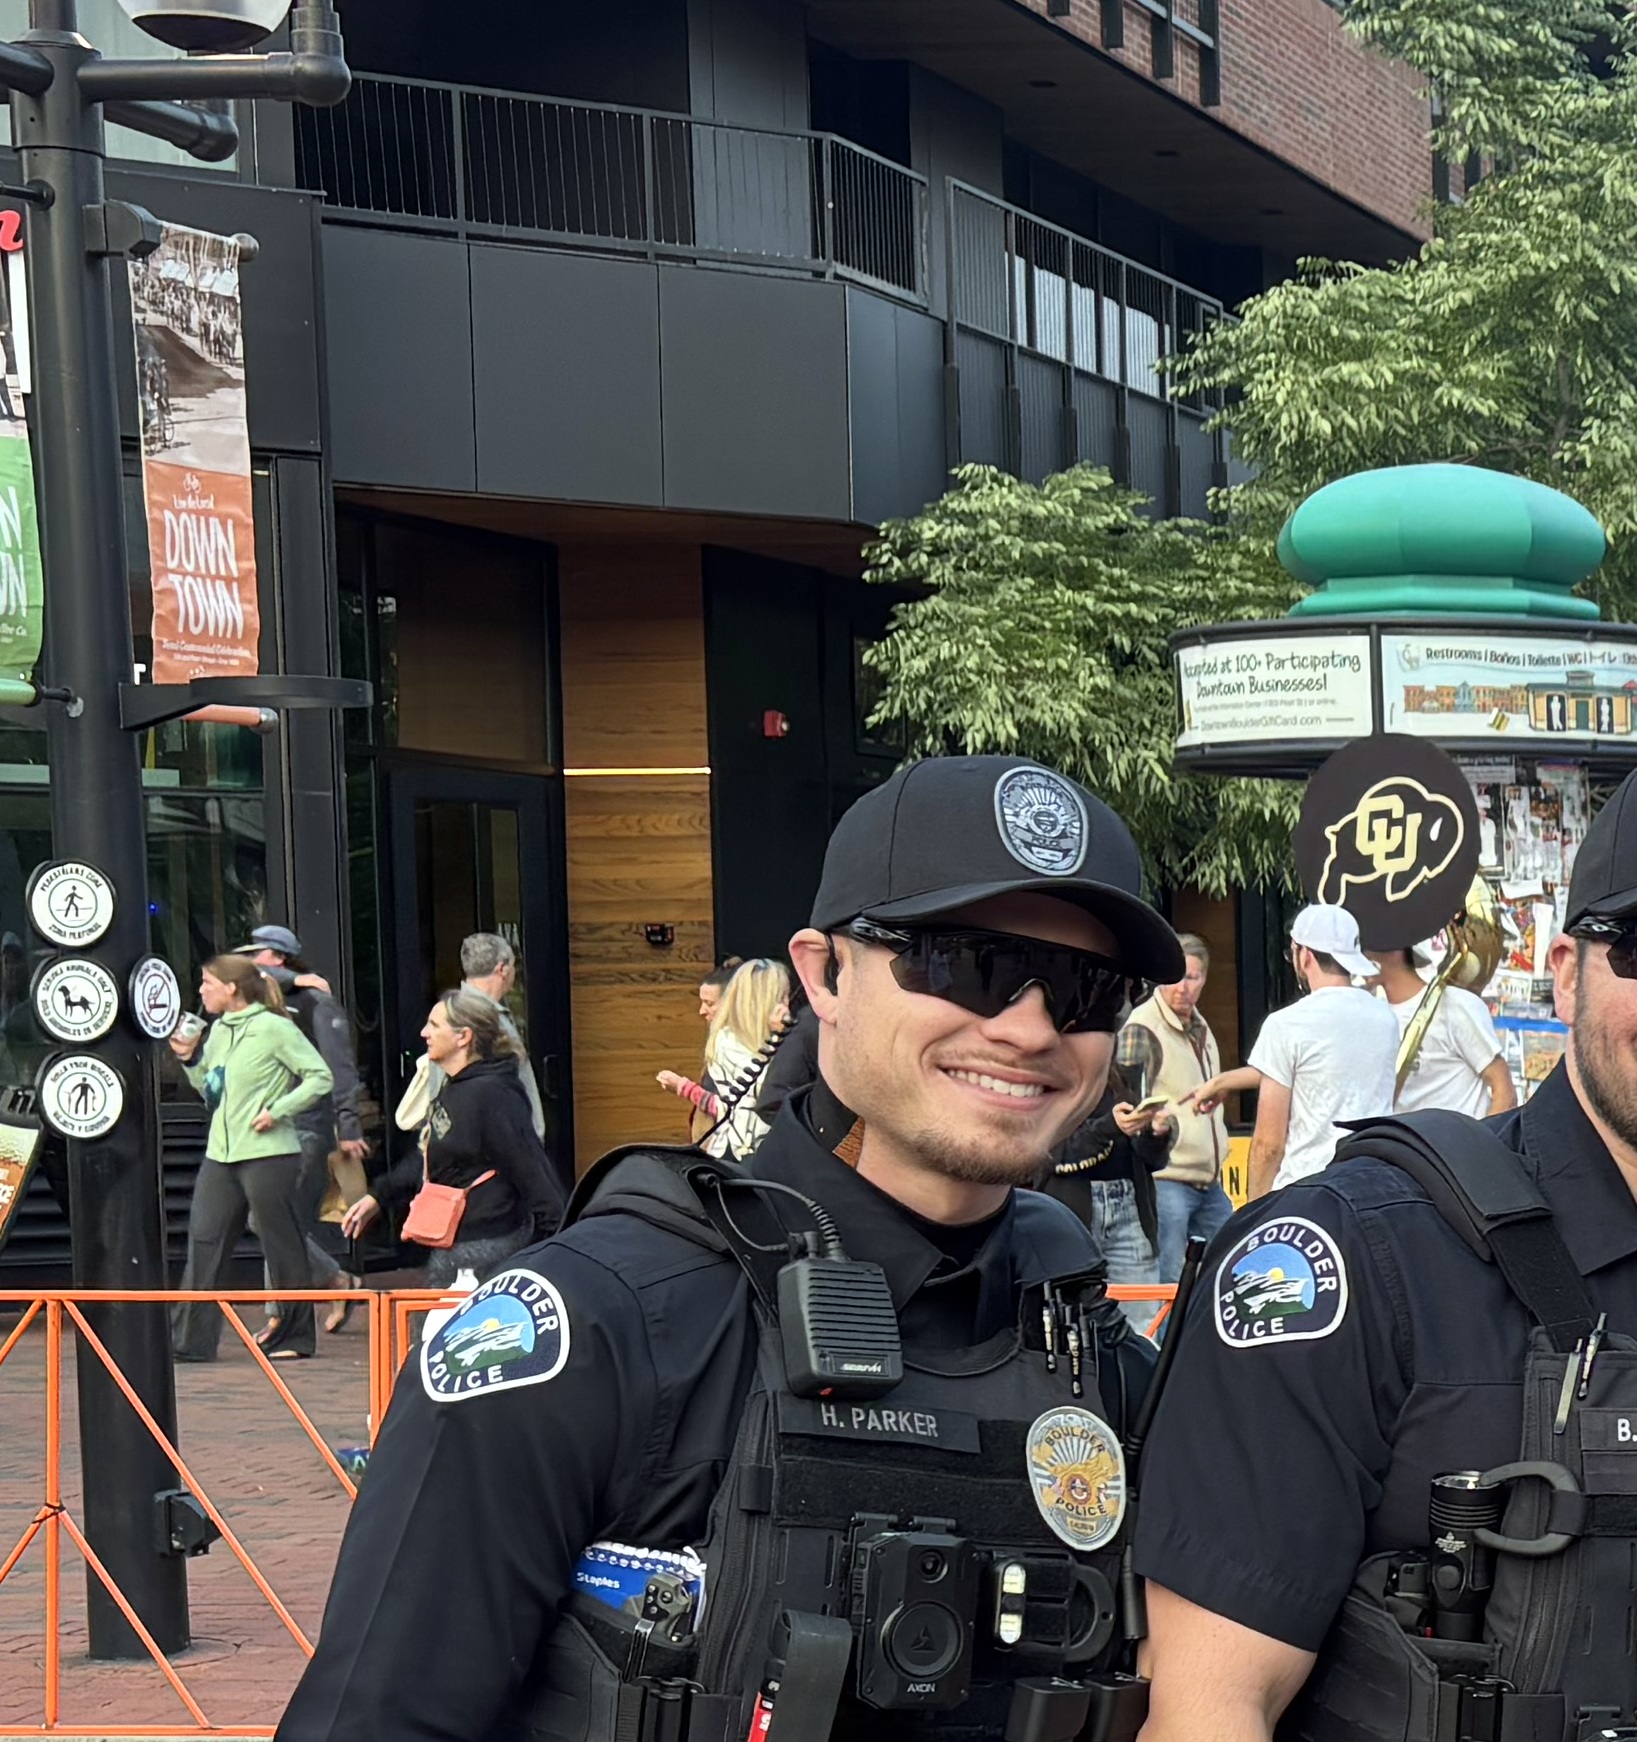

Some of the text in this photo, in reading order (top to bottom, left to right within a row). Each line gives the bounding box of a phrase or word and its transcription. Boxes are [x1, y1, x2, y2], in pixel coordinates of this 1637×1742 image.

[163, 509, 239, 578] DOWN
[168, 573, 244, 640] TOWN
[1220, 657, 1232, 676] at
[1236, 653, 1262, 674] 100+
[1265, 650, 1361, 673] Participating
[1425, 647, 1483, 660] Restrooms
[1248, 673, 1328, 695] Businesses!
[1355, 794, 1423, 874] CU
[1246, 1224, 1337, 1293] BOULDER
[1220, 1290, 1285, 1340] POLICE
[428, 1350, 504, 1393] POLICE
[821, 1403, 938, 1438] H. PARKER
[1044, 1426, 1106, 1453] BOULDER
[1055, 1497, 1107, 1517] POLICE
[576, 1571, 621, 1590] Staples
[907, 1683, 936, 1694] AXON
